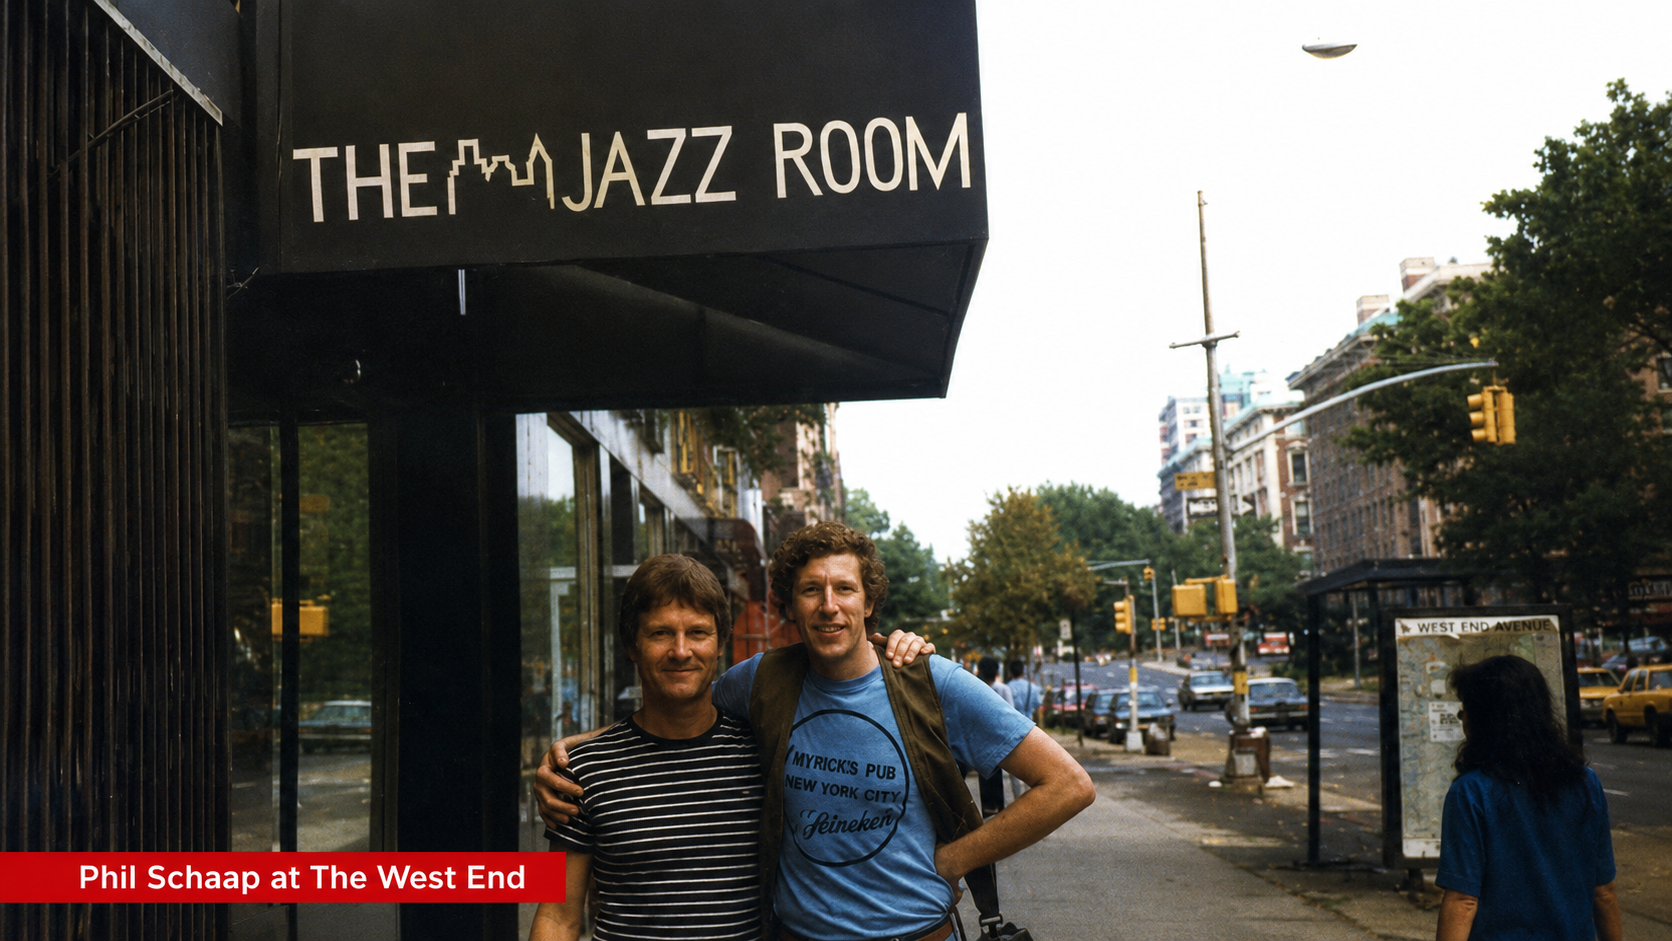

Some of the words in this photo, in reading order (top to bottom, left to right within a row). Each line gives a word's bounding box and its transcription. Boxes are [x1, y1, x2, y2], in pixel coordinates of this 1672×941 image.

[292, 140, 438, 223] THE
[562, 125, 737, 213] JAZZ
[772, 112, 972, 199] ROOM
[1417, 621, 1455, 633] WEST
[1461, 621, 1490, 633] END
[1494, 619, 1551, 632] AVENUE
[792, 751, 859, 776] MYRICK'S
[865, 763, 897, 780] PUB
[784, 774, 818, 792] NEW
[821, 782, 860, 800] YORK
[864, 789, 902, 803] CITY
[799, 808, 894, 841] Heineken
